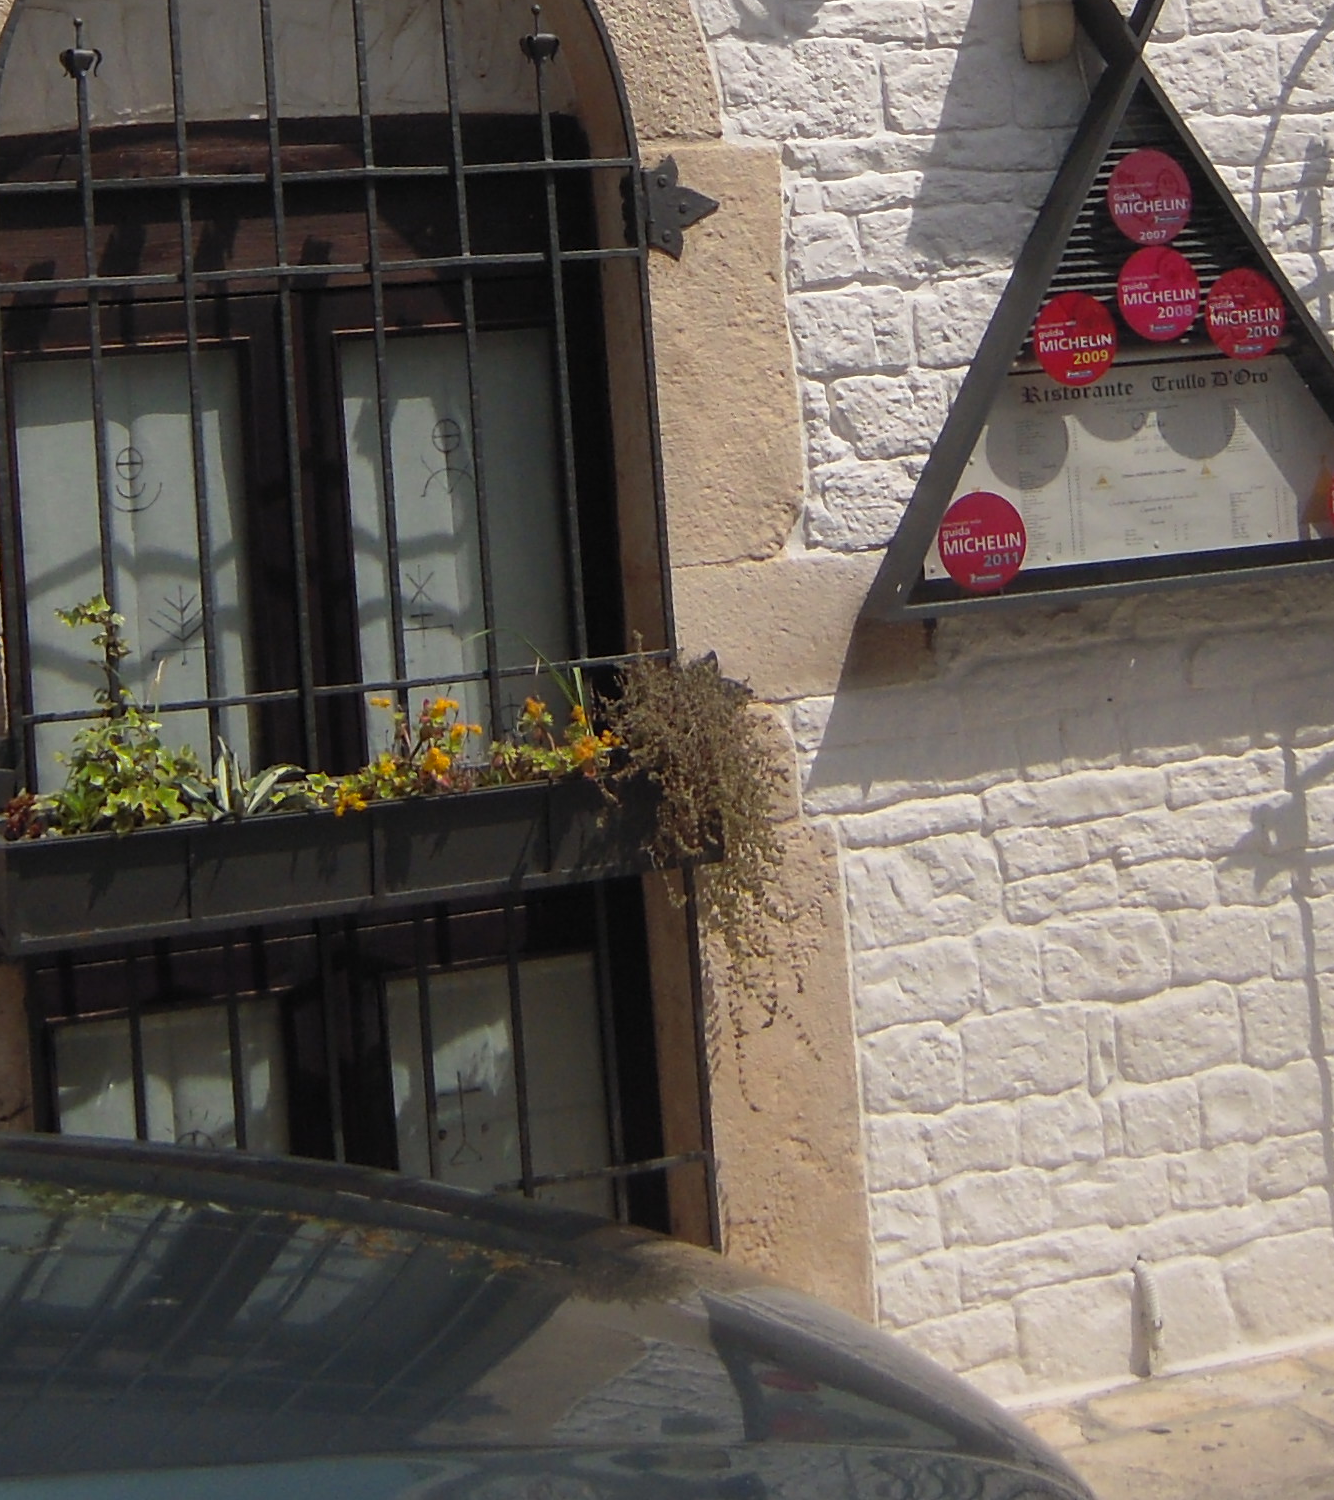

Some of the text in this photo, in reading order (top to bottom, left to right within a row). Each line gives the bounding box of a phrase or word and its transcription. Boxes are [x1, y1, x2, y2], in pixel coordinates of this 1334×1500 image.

[1114, 198, 1186, 215] MICHELIN
[1139, 230, 1167, 241] 2007
[1123, 288, 1197, 305] MICHELIN
[1157, 304, 1193, 319] 2008
[1210, 307, 1280, 326] MICHELIN
[1247, 325, 1279, 338] 2010
[1039, 333, 1113, 353] MICHELIN
[1073, 349, 1109, 365] 2009
[1022, 381, 1134, 404] Ristorante
[1151, 373, 1206, 392] Trullo
[942, 526, 971, 540] guida
[943, 532, 1022, 556] MICHELIN
[983, 551, 1019, 567] 2011
